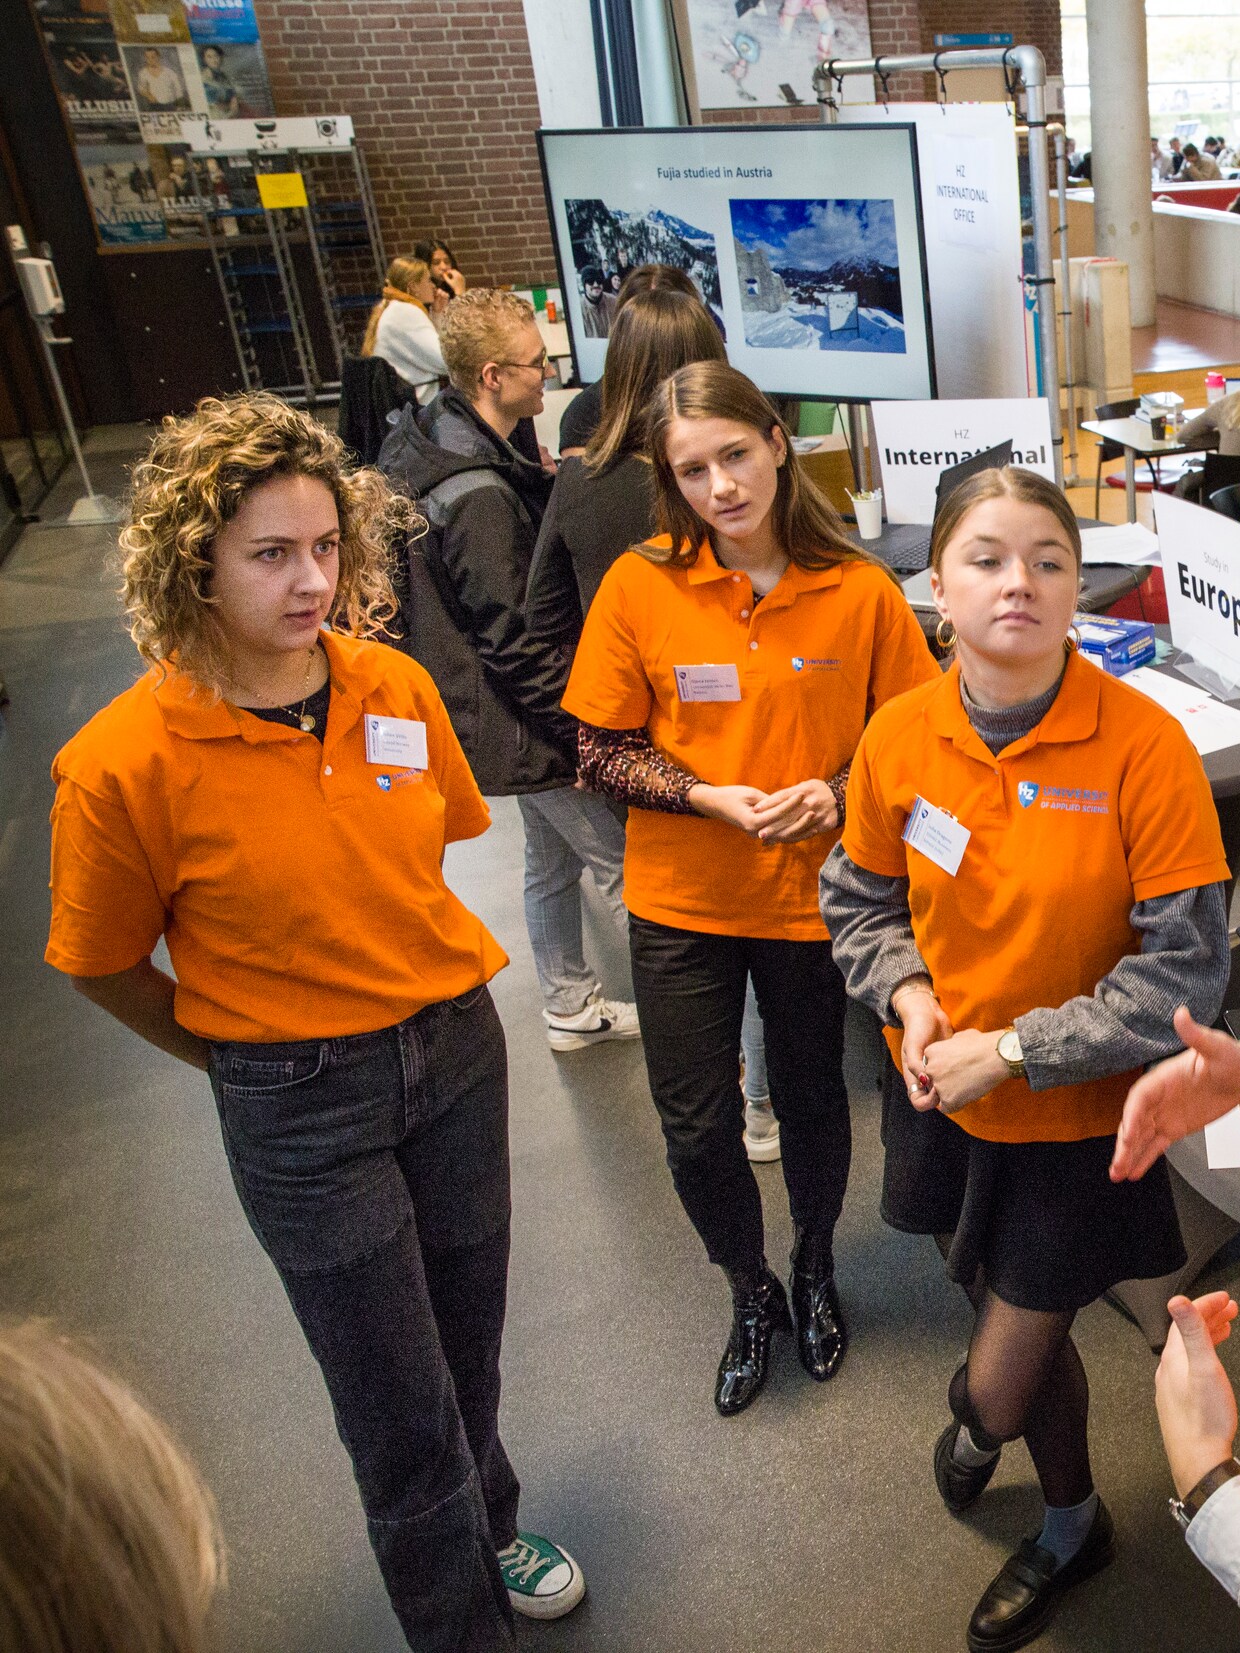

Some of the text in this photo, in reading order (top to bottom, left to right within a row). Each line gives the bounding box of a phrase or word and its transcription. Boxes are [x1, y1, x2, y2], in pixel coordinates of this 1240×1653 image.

[657, 166, 773, 180] Fujia studied in Austria
[956, 164, 966, 177] HZ
[163, 194, 231, 209] ILLUSE
[936, 185, 989, 203] INTERNATIONAL
[953, 208, 976, 223] OFFICE
[954, 429, 970, 439] HZ
[885, 445, 1046, 465] Internanal
[1203, 552, 1229, 573] Study in
[1018, 781, 1035, 801] HZ
[1041, 801, 1050, 809] OF
[1050, 802, 1081, 812] APPLIED
